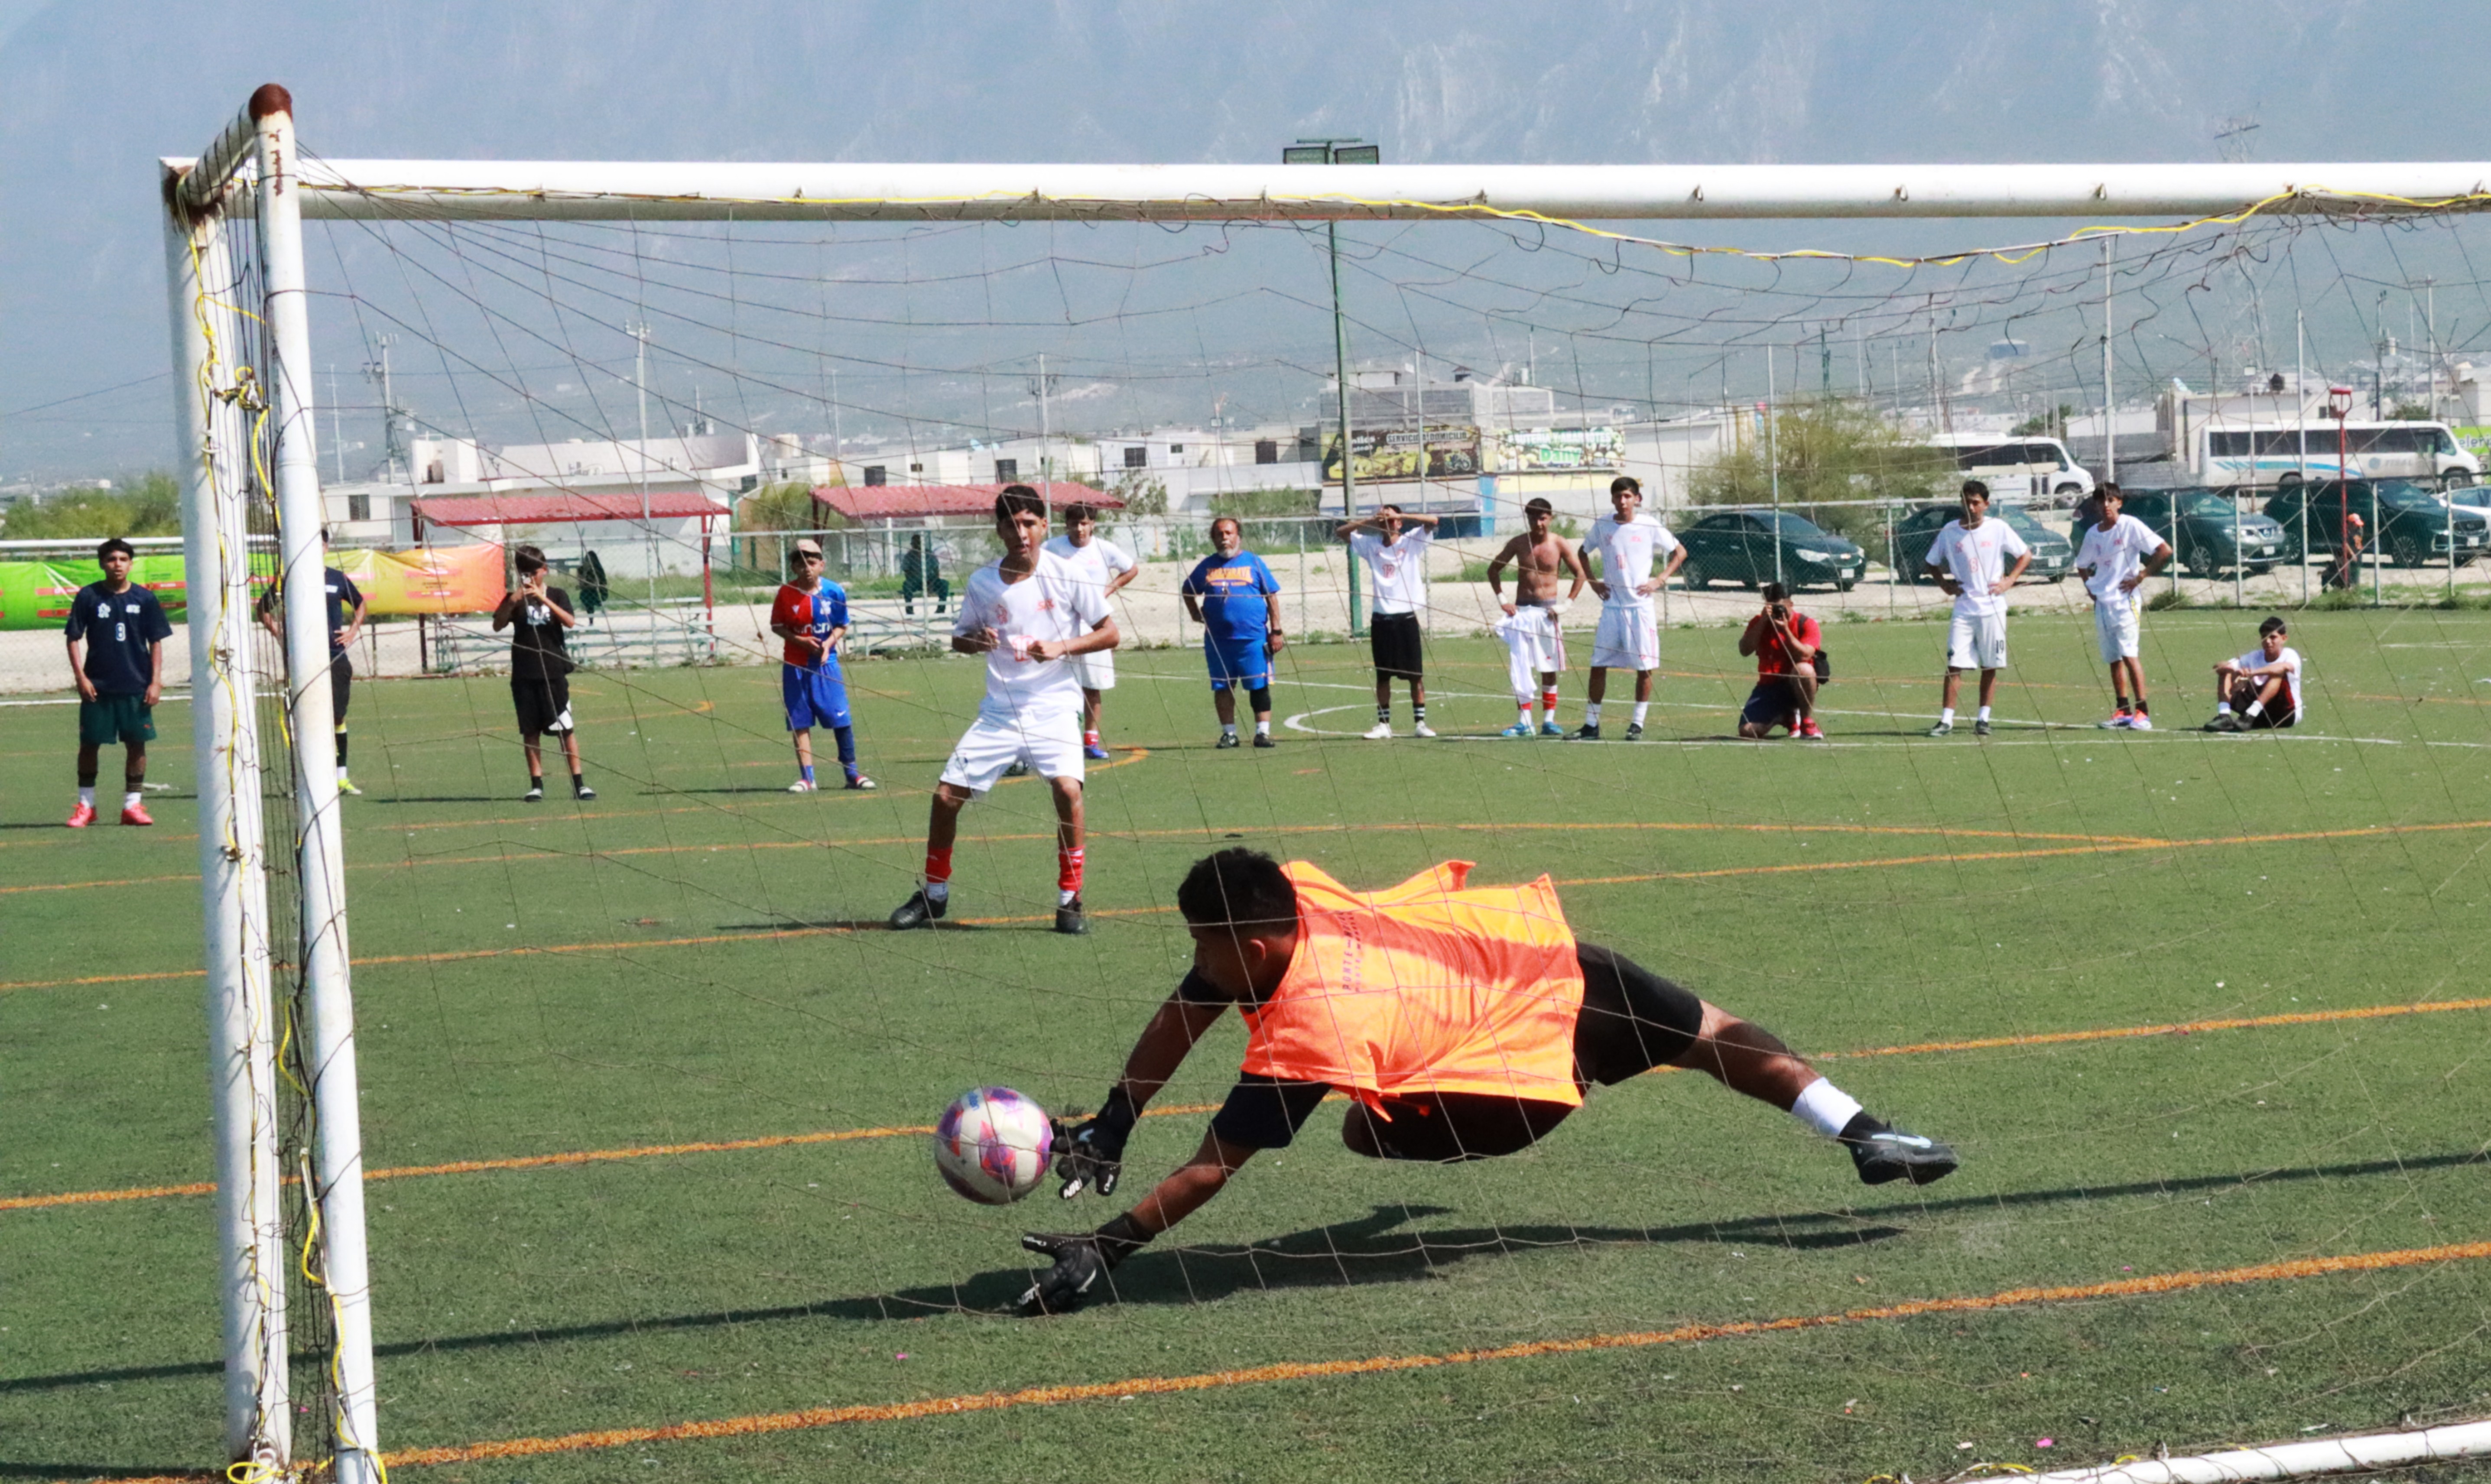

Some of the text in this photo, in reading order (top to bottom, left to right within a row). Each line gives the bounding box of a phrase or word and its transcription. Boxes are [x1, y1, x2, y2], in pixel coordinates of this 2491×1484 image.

[1430, 432, 1467, 441] DOMICILIO
[1541, 448, 1581, 465] Dany
[1996, 640, 2004, 653] 19
